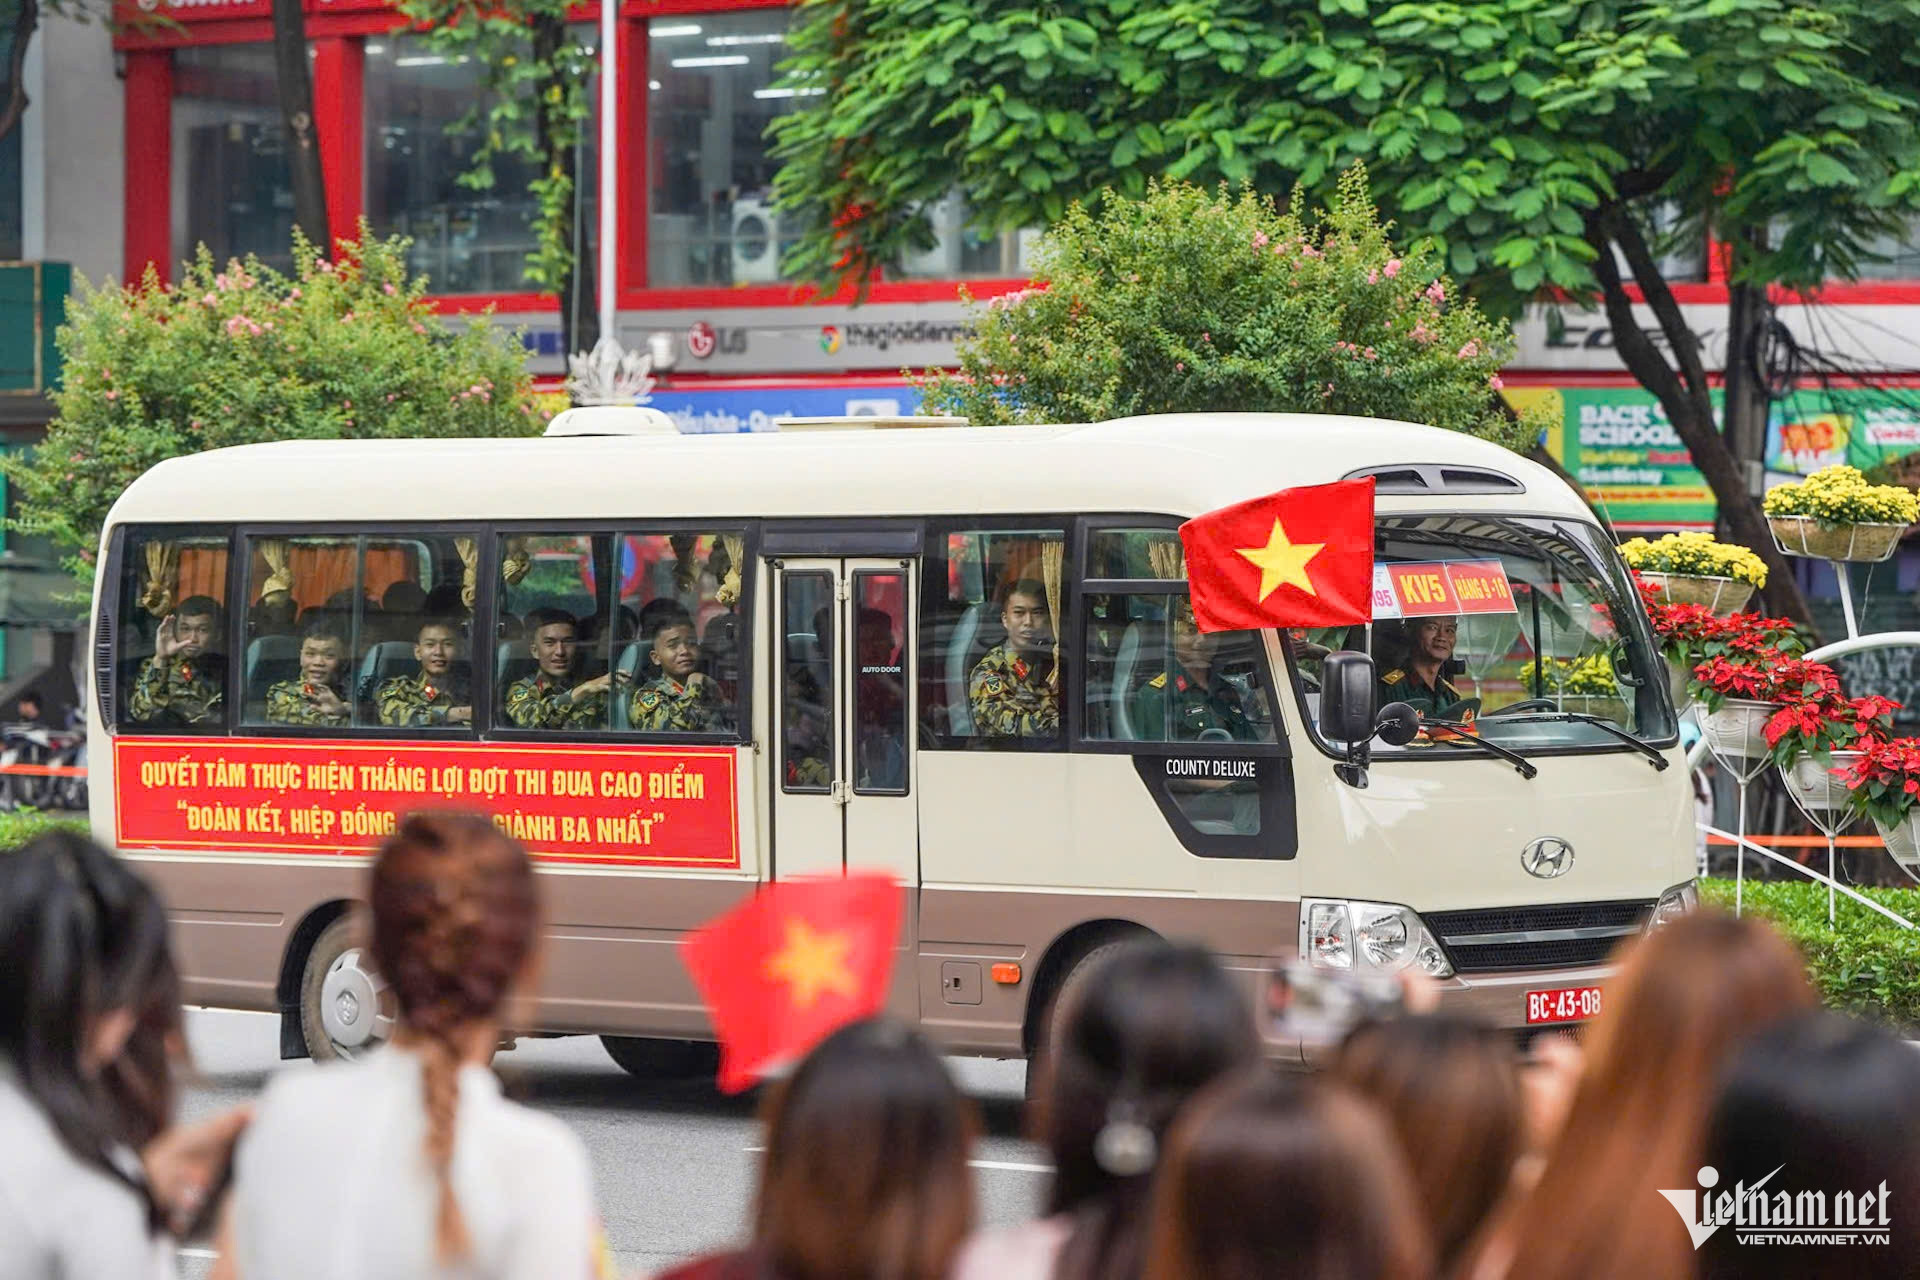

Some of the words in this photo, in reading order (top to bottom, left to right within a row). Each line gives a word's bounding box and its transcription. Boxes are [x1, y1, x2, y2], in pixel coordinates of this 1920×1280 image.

[1580, 405, 1651, 424] BACK
[1580, 425, 1682, 445] SCHOOL
[1400, 575, 1446, 603] KV5
[141, 755, 199, 788] QUYẾT
[204, 758, 246, 788] TÂM
[251, 762, 301, 794] THỰC
[307, 761, 354, 795] HIỆN
[360, 757, 426, 793] THẮNG
[432, 766, 464, 799] LỢI
[469, 766, 509, 799] ĐỢT
[514, 769, 547, 795] THI
[552, 770, 594, 797] ĐUA
[600, 771, 642, 798] CAO
[648, 763, 704, 802] ĐIỂM
[1166, 759, 1210, 776] COUNTY
[1213, 760, 1256, 777] DELUXE
[246, 800, 286, 836] KẾT,
[290, 804, 336, 839] HIỆP
[562, 816, 592, 842] BA
[1529, 989, 1602, 1020] BC-43-08
